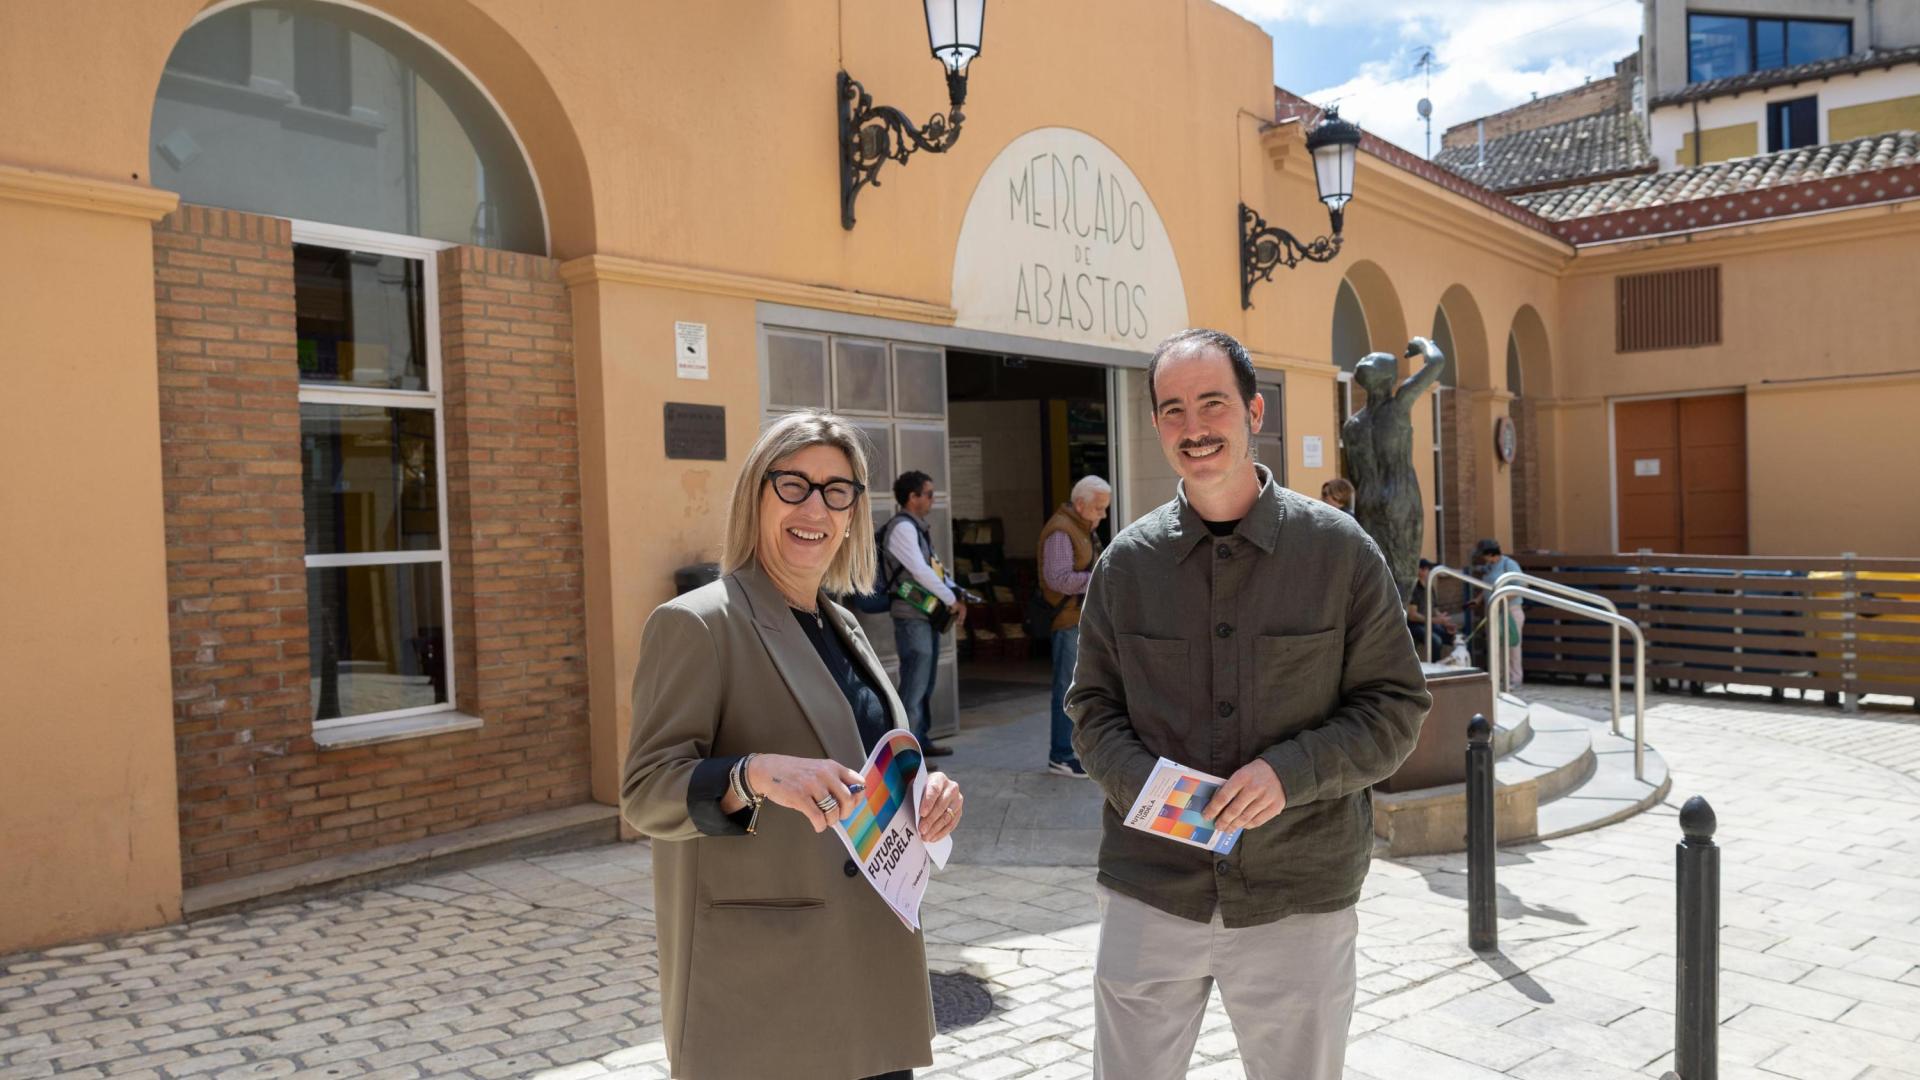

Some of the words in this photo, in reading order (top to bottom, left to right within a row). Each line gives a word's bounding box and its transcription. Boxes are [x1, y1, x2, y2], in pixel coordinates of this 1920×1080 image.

[1010, 153, 1144, 250] MERCADO
[1075, 244, 1091, 266] DE
[1015, 264, 1147, 339] ABASTOS
[1130, 805, 1147, 825] FUTURA
[1140, 799, 1156, 820] TUDELA
[868, 828, 899, 879] FUTURA
[883, 827, 914, 876] TUDELA
